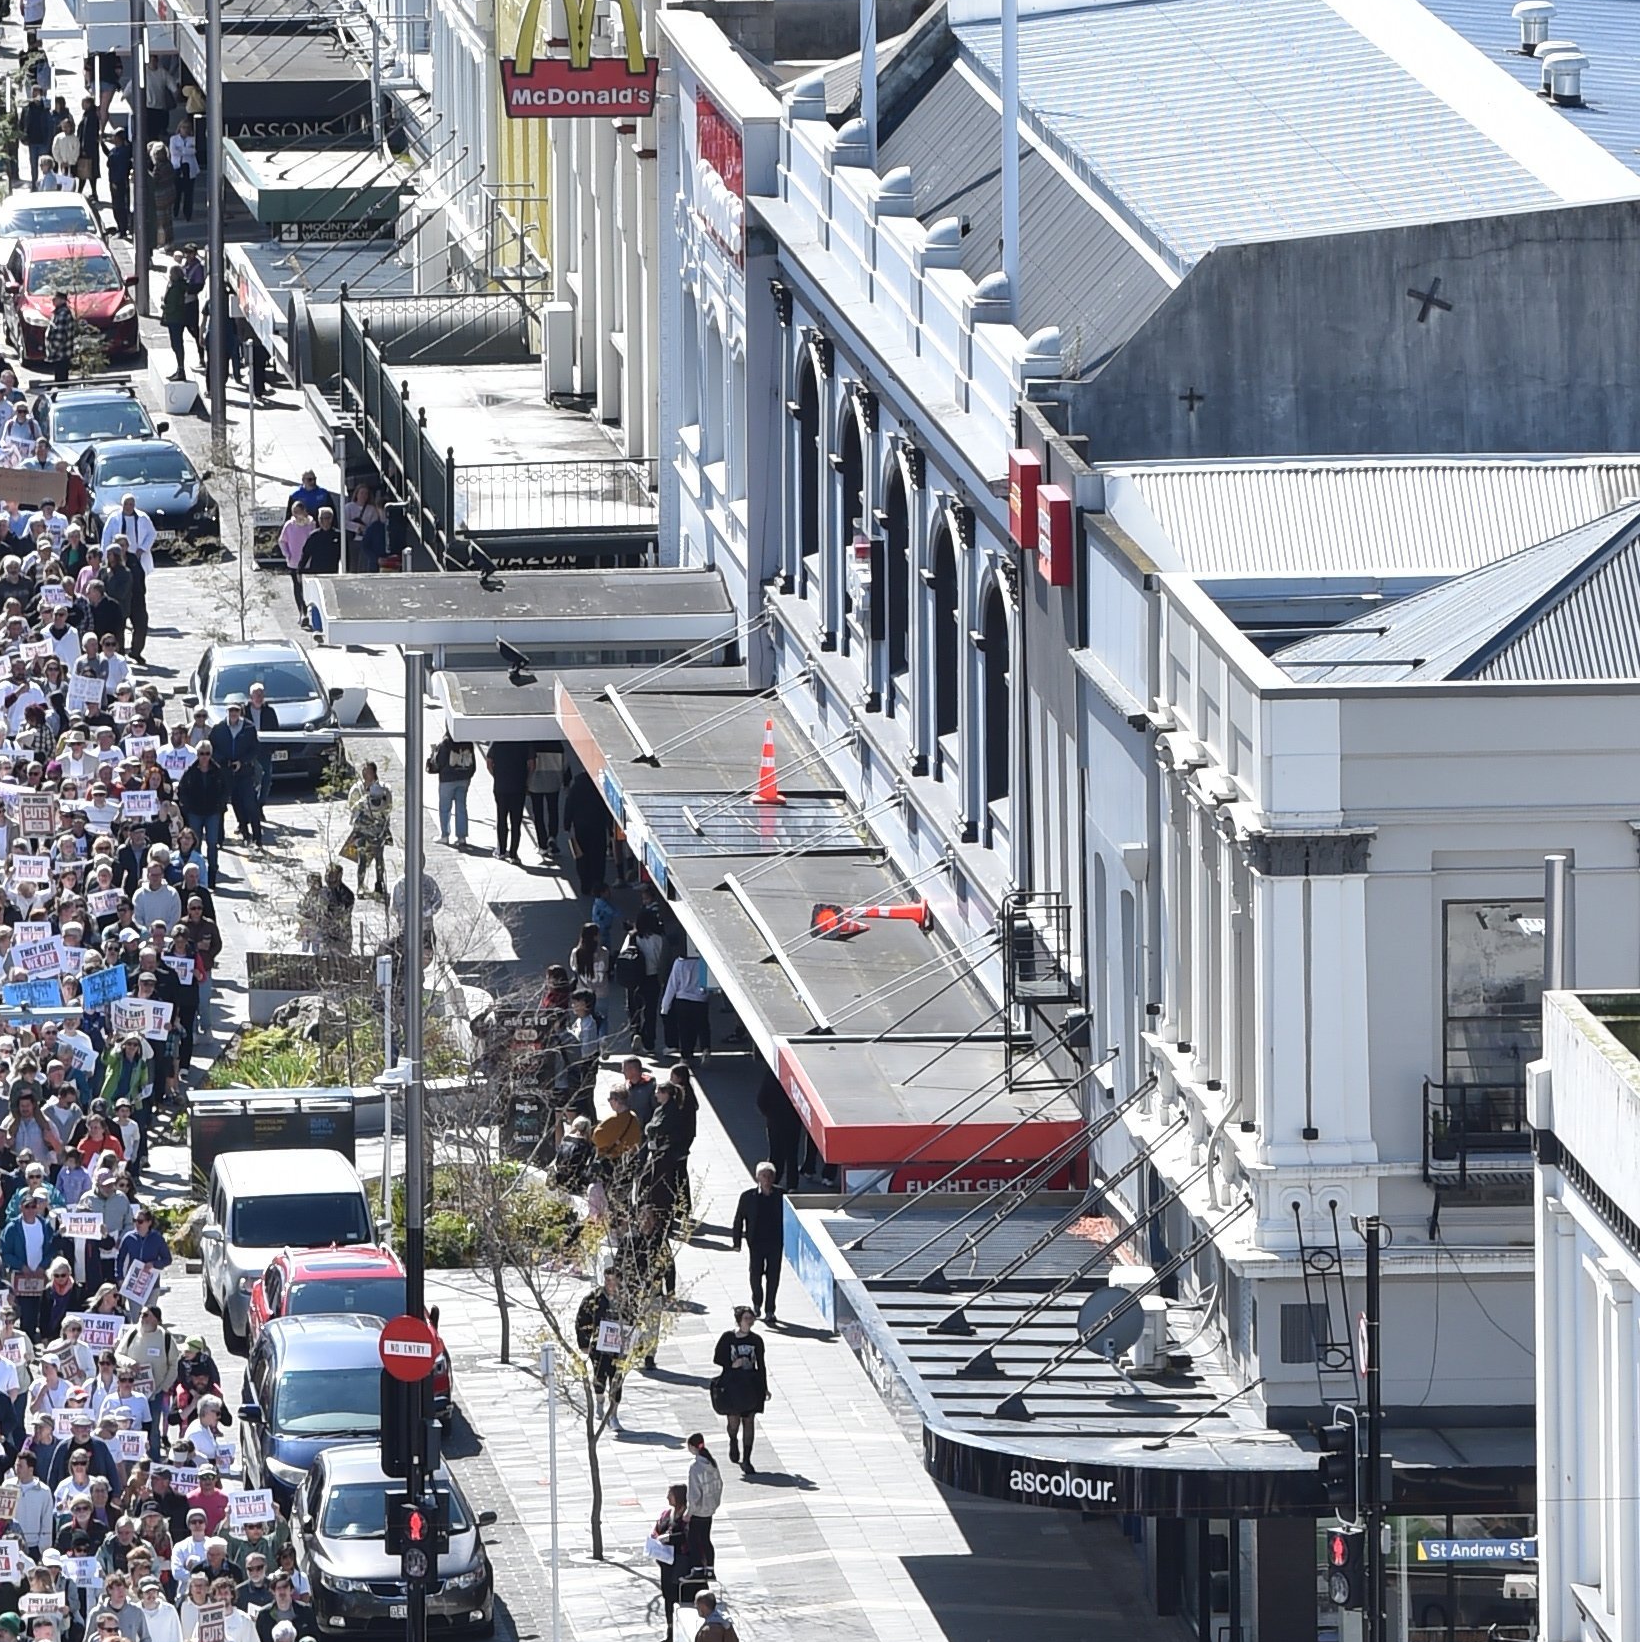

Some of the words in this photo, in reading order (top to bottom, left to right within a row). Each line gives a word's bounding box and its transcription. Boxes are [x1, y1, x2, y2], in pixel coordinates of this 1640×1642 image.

[511, 88, 651, 106] McDonald's
[223, 121, 333, 137] LASSONS
[301, 222, 368, 230] MOUNTAIN
[24, 808, 49, 818] CUTS
[19, 947, 36, 958] THEY
[37, 942, 56, 953] SAVE
[905, 1180, 973, 1193] FLIGHT
[975, 1178, 1049, 1191] CENTRE
[1010, 1469, 1117, 1502] ascolour.
[1430, 1543, 1447, 1558] St
[1450, 1543, 1505, 1557] Andrew
[1509, 1542, 1527, 1557] St
[202, 1627, 224, 1642] CUTS
